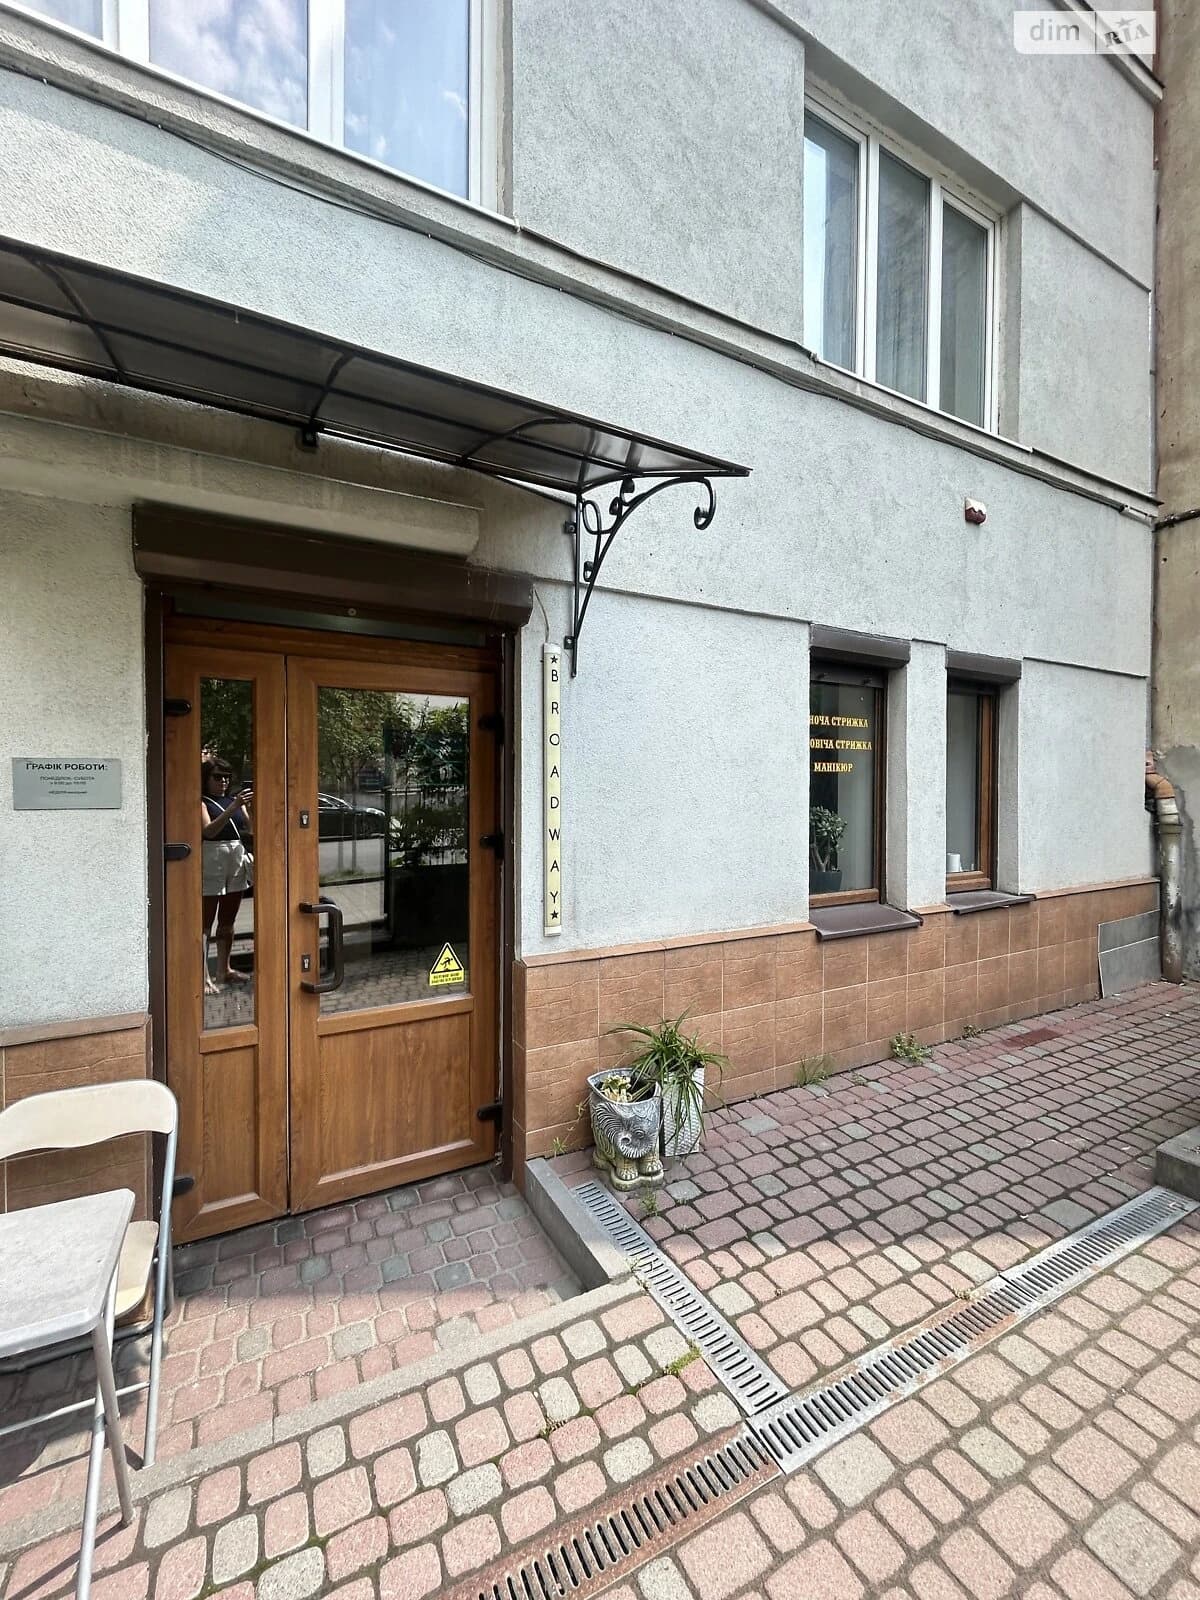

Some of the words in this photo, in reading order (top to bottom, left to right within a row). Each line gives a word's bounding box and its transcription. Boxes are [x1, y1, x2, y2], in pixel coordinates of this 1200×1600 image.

[831, 716, 869, 728] СТРИЖКА
[835, 740, 872, 751] СТРИЖКА
[26, 763, 62, 771] ГРАФІК
[64, 763, 108, 771] РОБОТИ:
[813, 762, 853, 773] МАНІКЮР
[549, 669, 560, 904] BROADWAY
